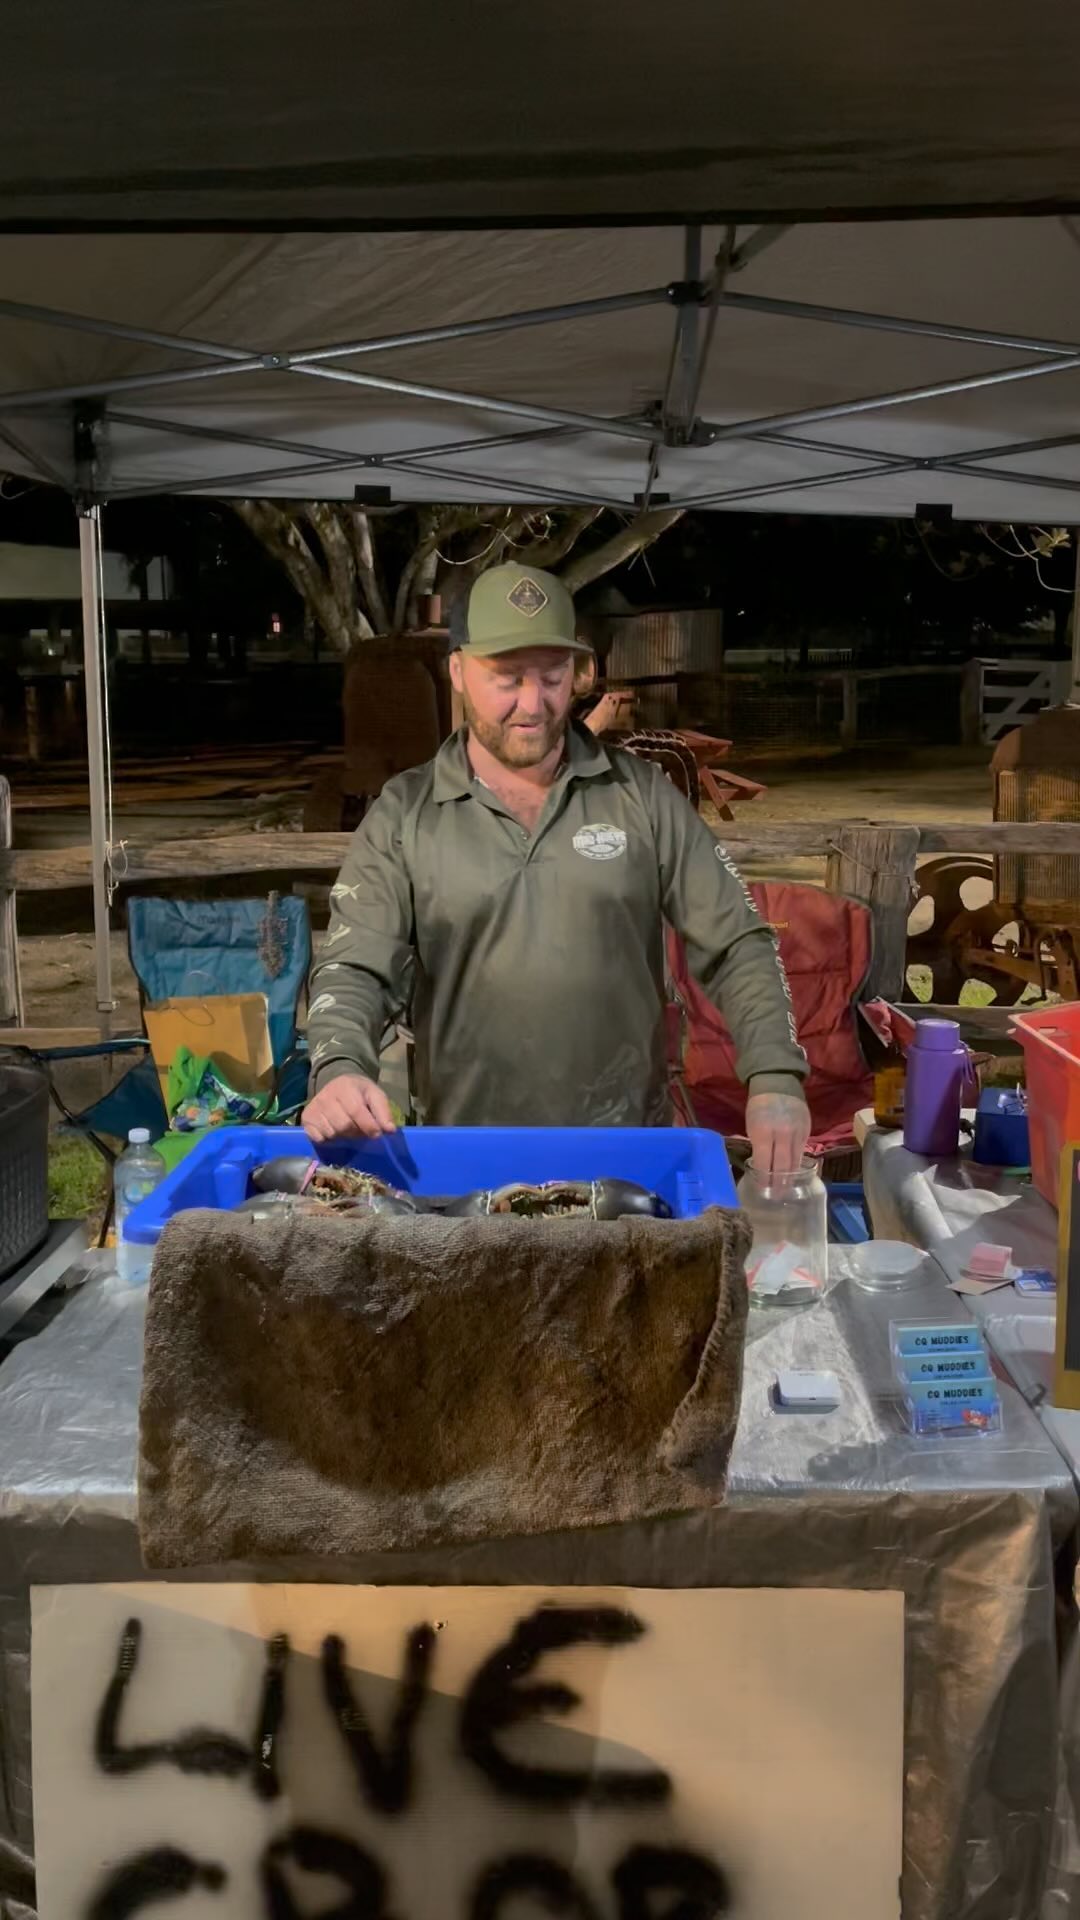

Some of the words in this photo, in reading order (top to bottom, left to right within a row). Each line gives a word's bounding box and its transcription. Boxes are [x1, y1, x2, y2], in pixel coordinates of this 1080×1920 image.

[915, 1337, 928, 1346] CQ
[930, 1335, 969, 1345] MUDDIES
[921, 1363, 934, 1373] CQ
[937, 1361, 976, 1372] MUDDIES
[927, 1389, 940, 1399] CQ
[943, 1387, 983, 1398] MUDDIES
[96, 1604, 674, 1813] LIVE
